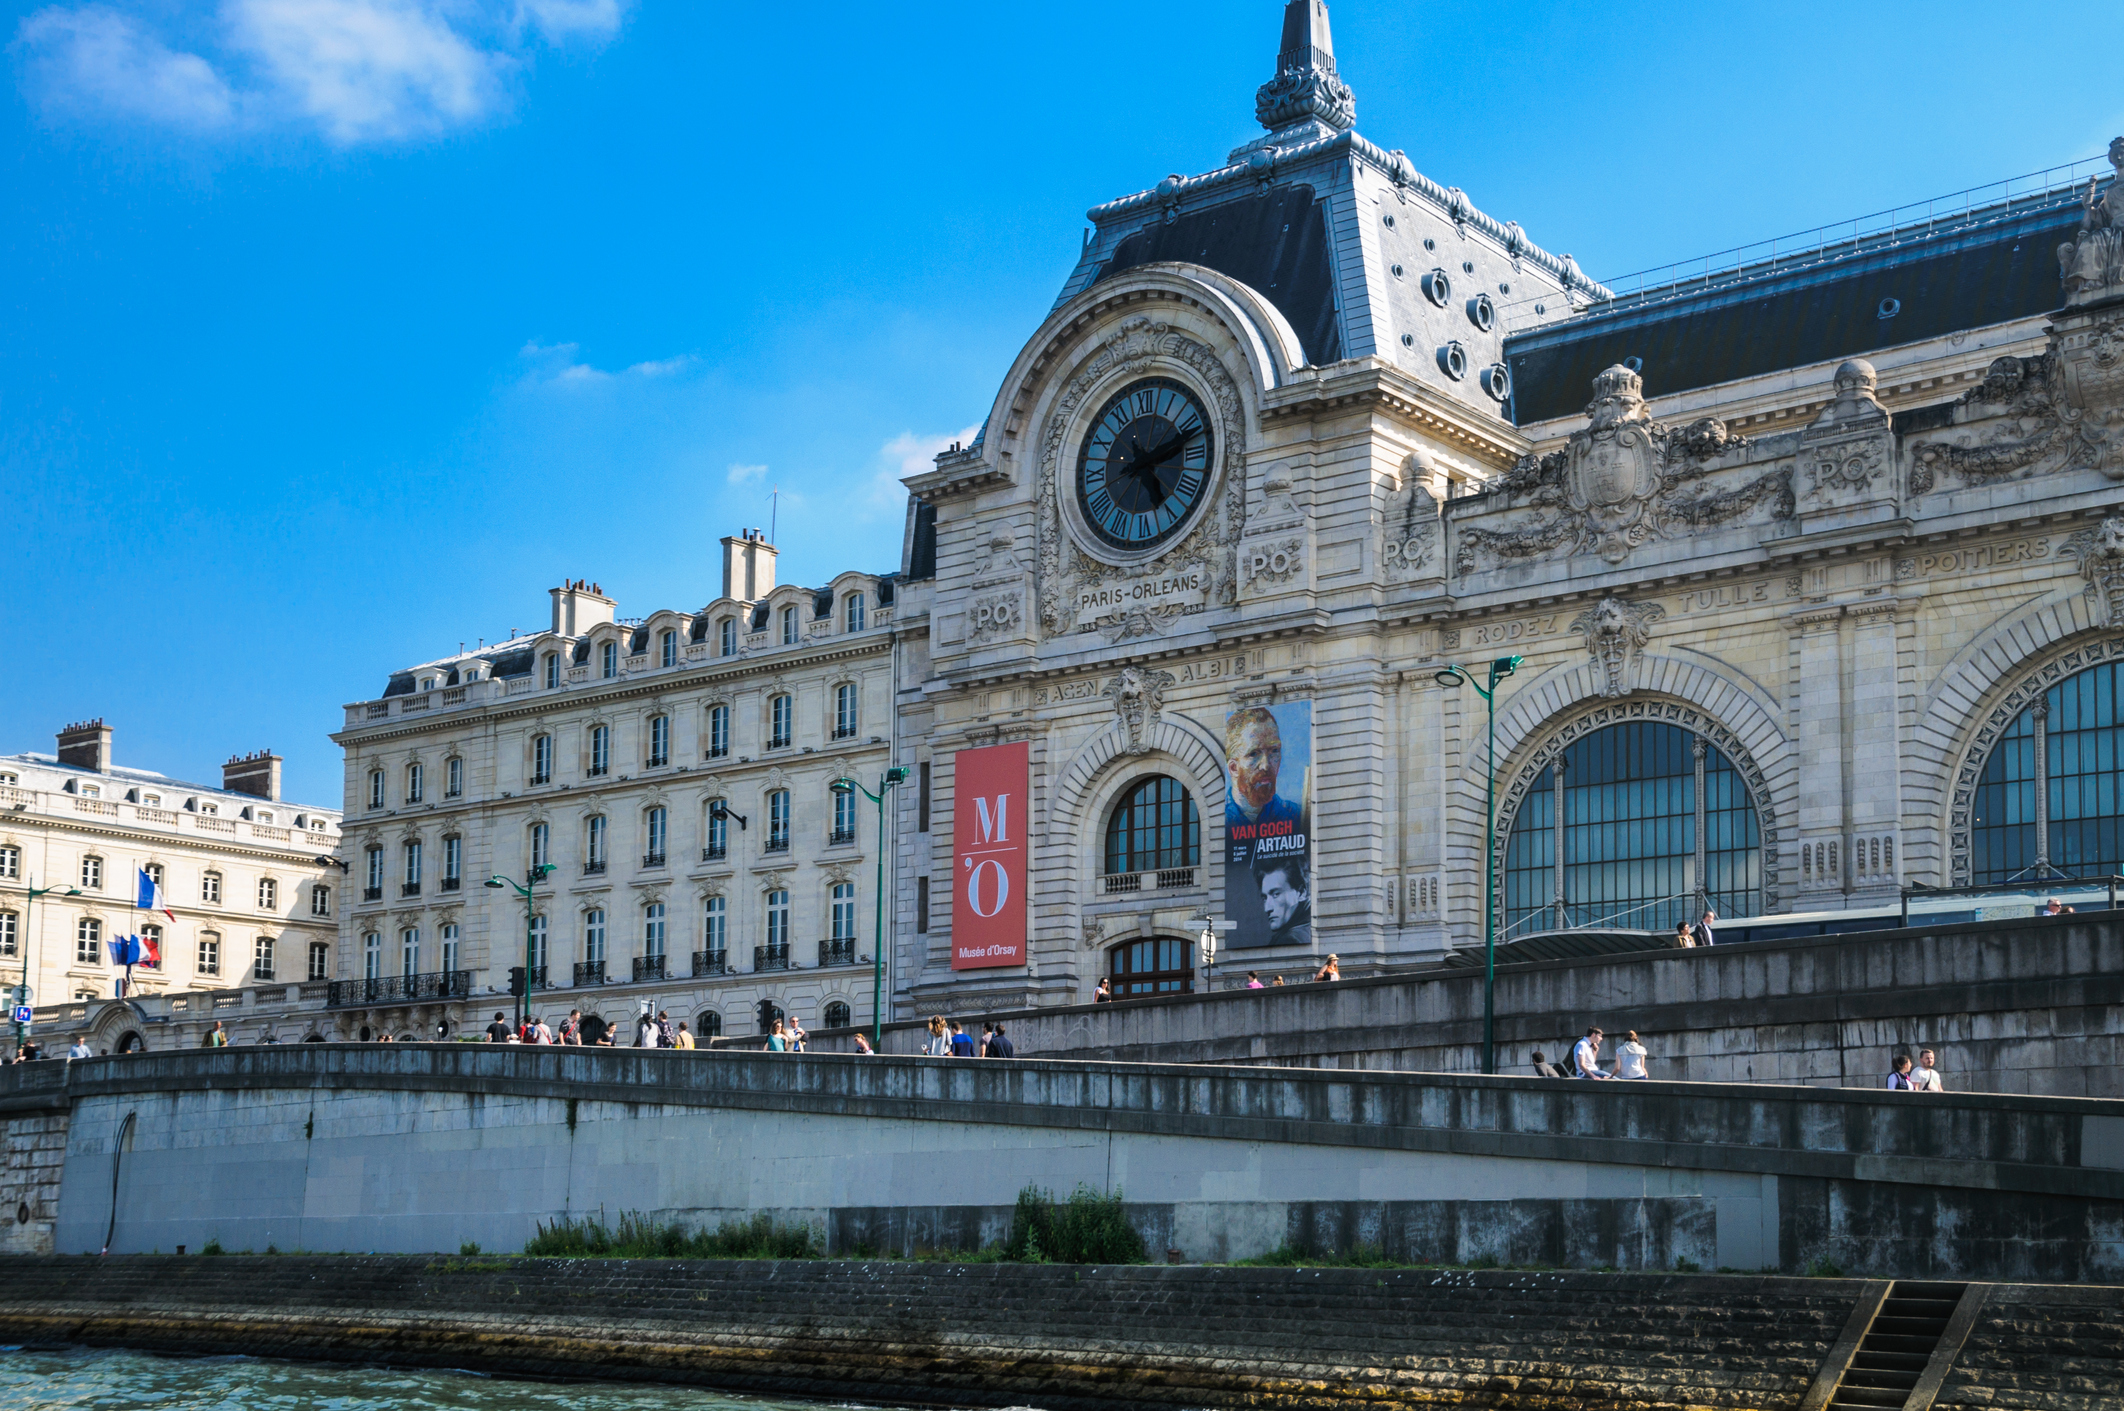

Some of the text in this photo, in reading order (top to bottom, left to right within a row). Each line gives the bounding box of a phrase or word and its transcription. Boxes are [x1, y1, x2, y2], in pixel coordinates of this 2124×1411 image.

[1816, 456, 1867, 488] PO
[1250, 549, 1291, 578] PO
[1382, 537, 1425, 566] PO
[1921, 537, 2049, 576] POITIERS
[1081, 574, 1200, 610] PARIS-ORLEANS
[1678, 581, 1769, 613] TULLE
[977, 600, 1012, 629] PO
[1475, 615, 1557, 645] RODEZ
[1181, 657, 1230, 683] ALBI
[1051, 679, 1098, 702] AGEN
[971, 793, 1011, 845] M
[1231, 820, 1293, 840] VAN GOGH
[959, 944, 1017, 958] Musée d'Orsay
